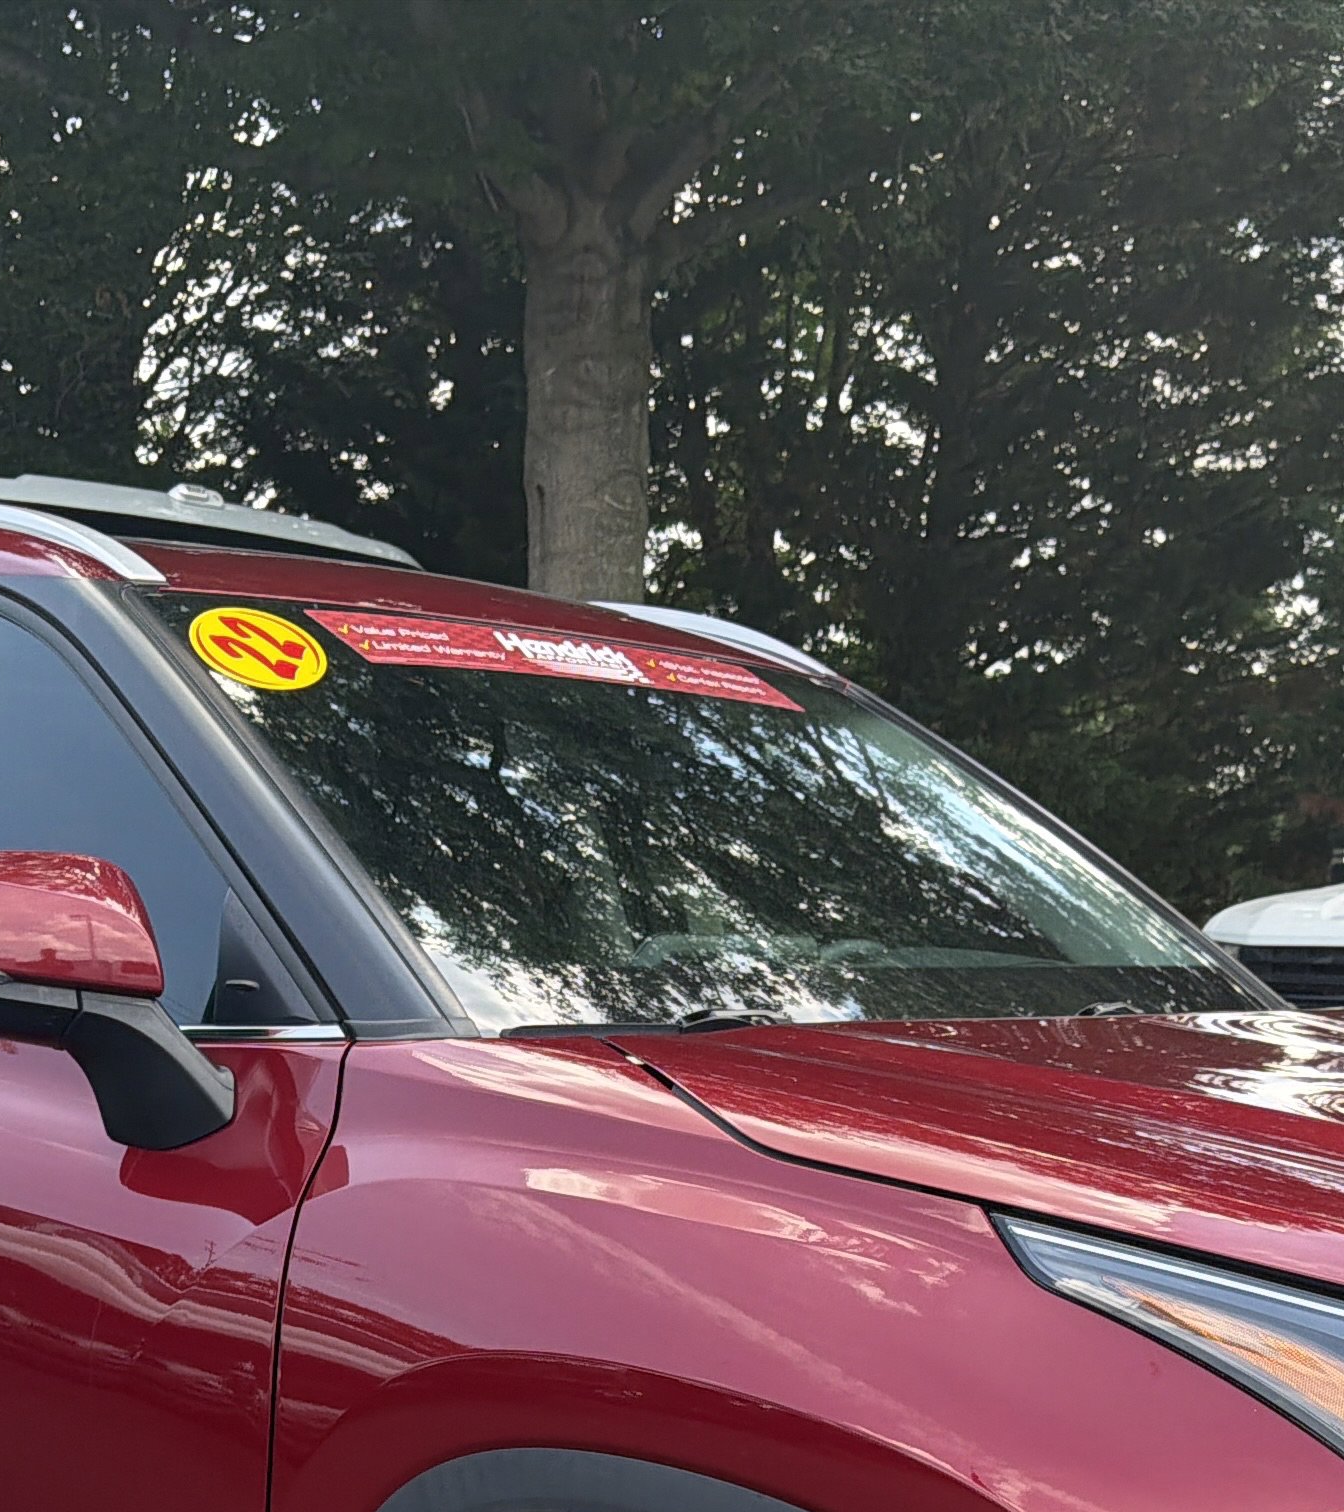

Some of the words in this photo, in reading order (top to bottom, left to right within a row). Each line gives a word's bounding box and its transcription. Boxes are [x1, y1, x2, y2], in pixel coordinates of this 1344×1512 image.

[349, 624, 396, 637] Value
[398, 627, 450, 641] Priced
[209, 616, 307, 680] 22
[371, 640, 432, 653] Limited
[432, 644, 506, 661] Warranty
[493, 630, 633, 669] Hendrick
